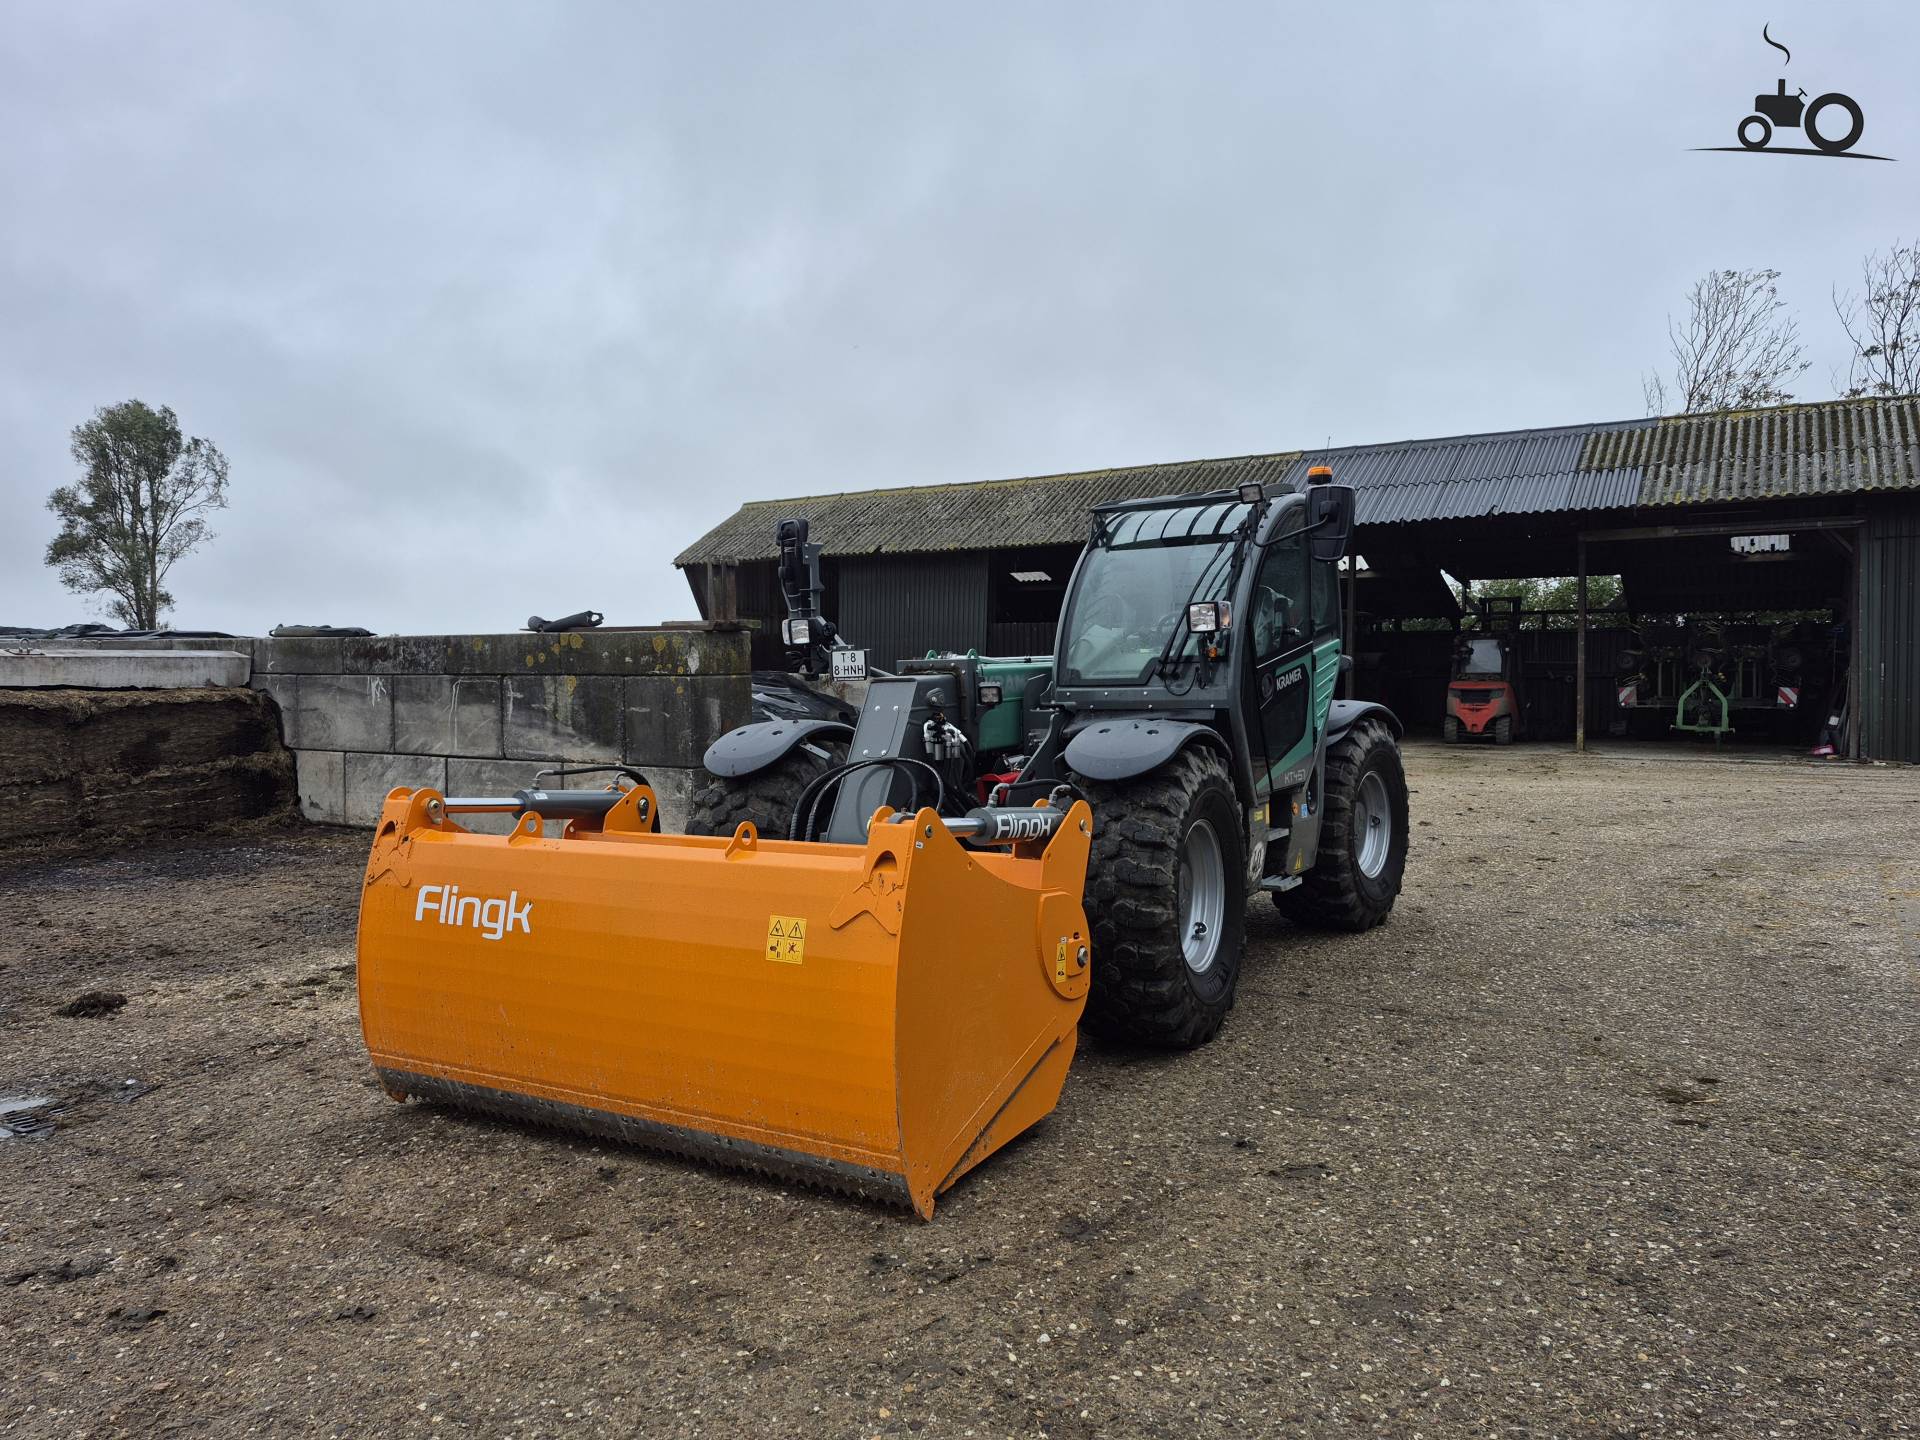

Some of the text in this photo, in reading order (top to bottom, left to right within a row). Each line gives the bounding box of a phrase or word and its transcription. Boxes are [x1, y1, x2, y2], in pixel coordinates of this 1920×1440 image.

[834, 664, 864, 676] 8-HNH
[1276, 668, 1302, 691] KRAMER
[415, 885, 533, 940] Flingk
